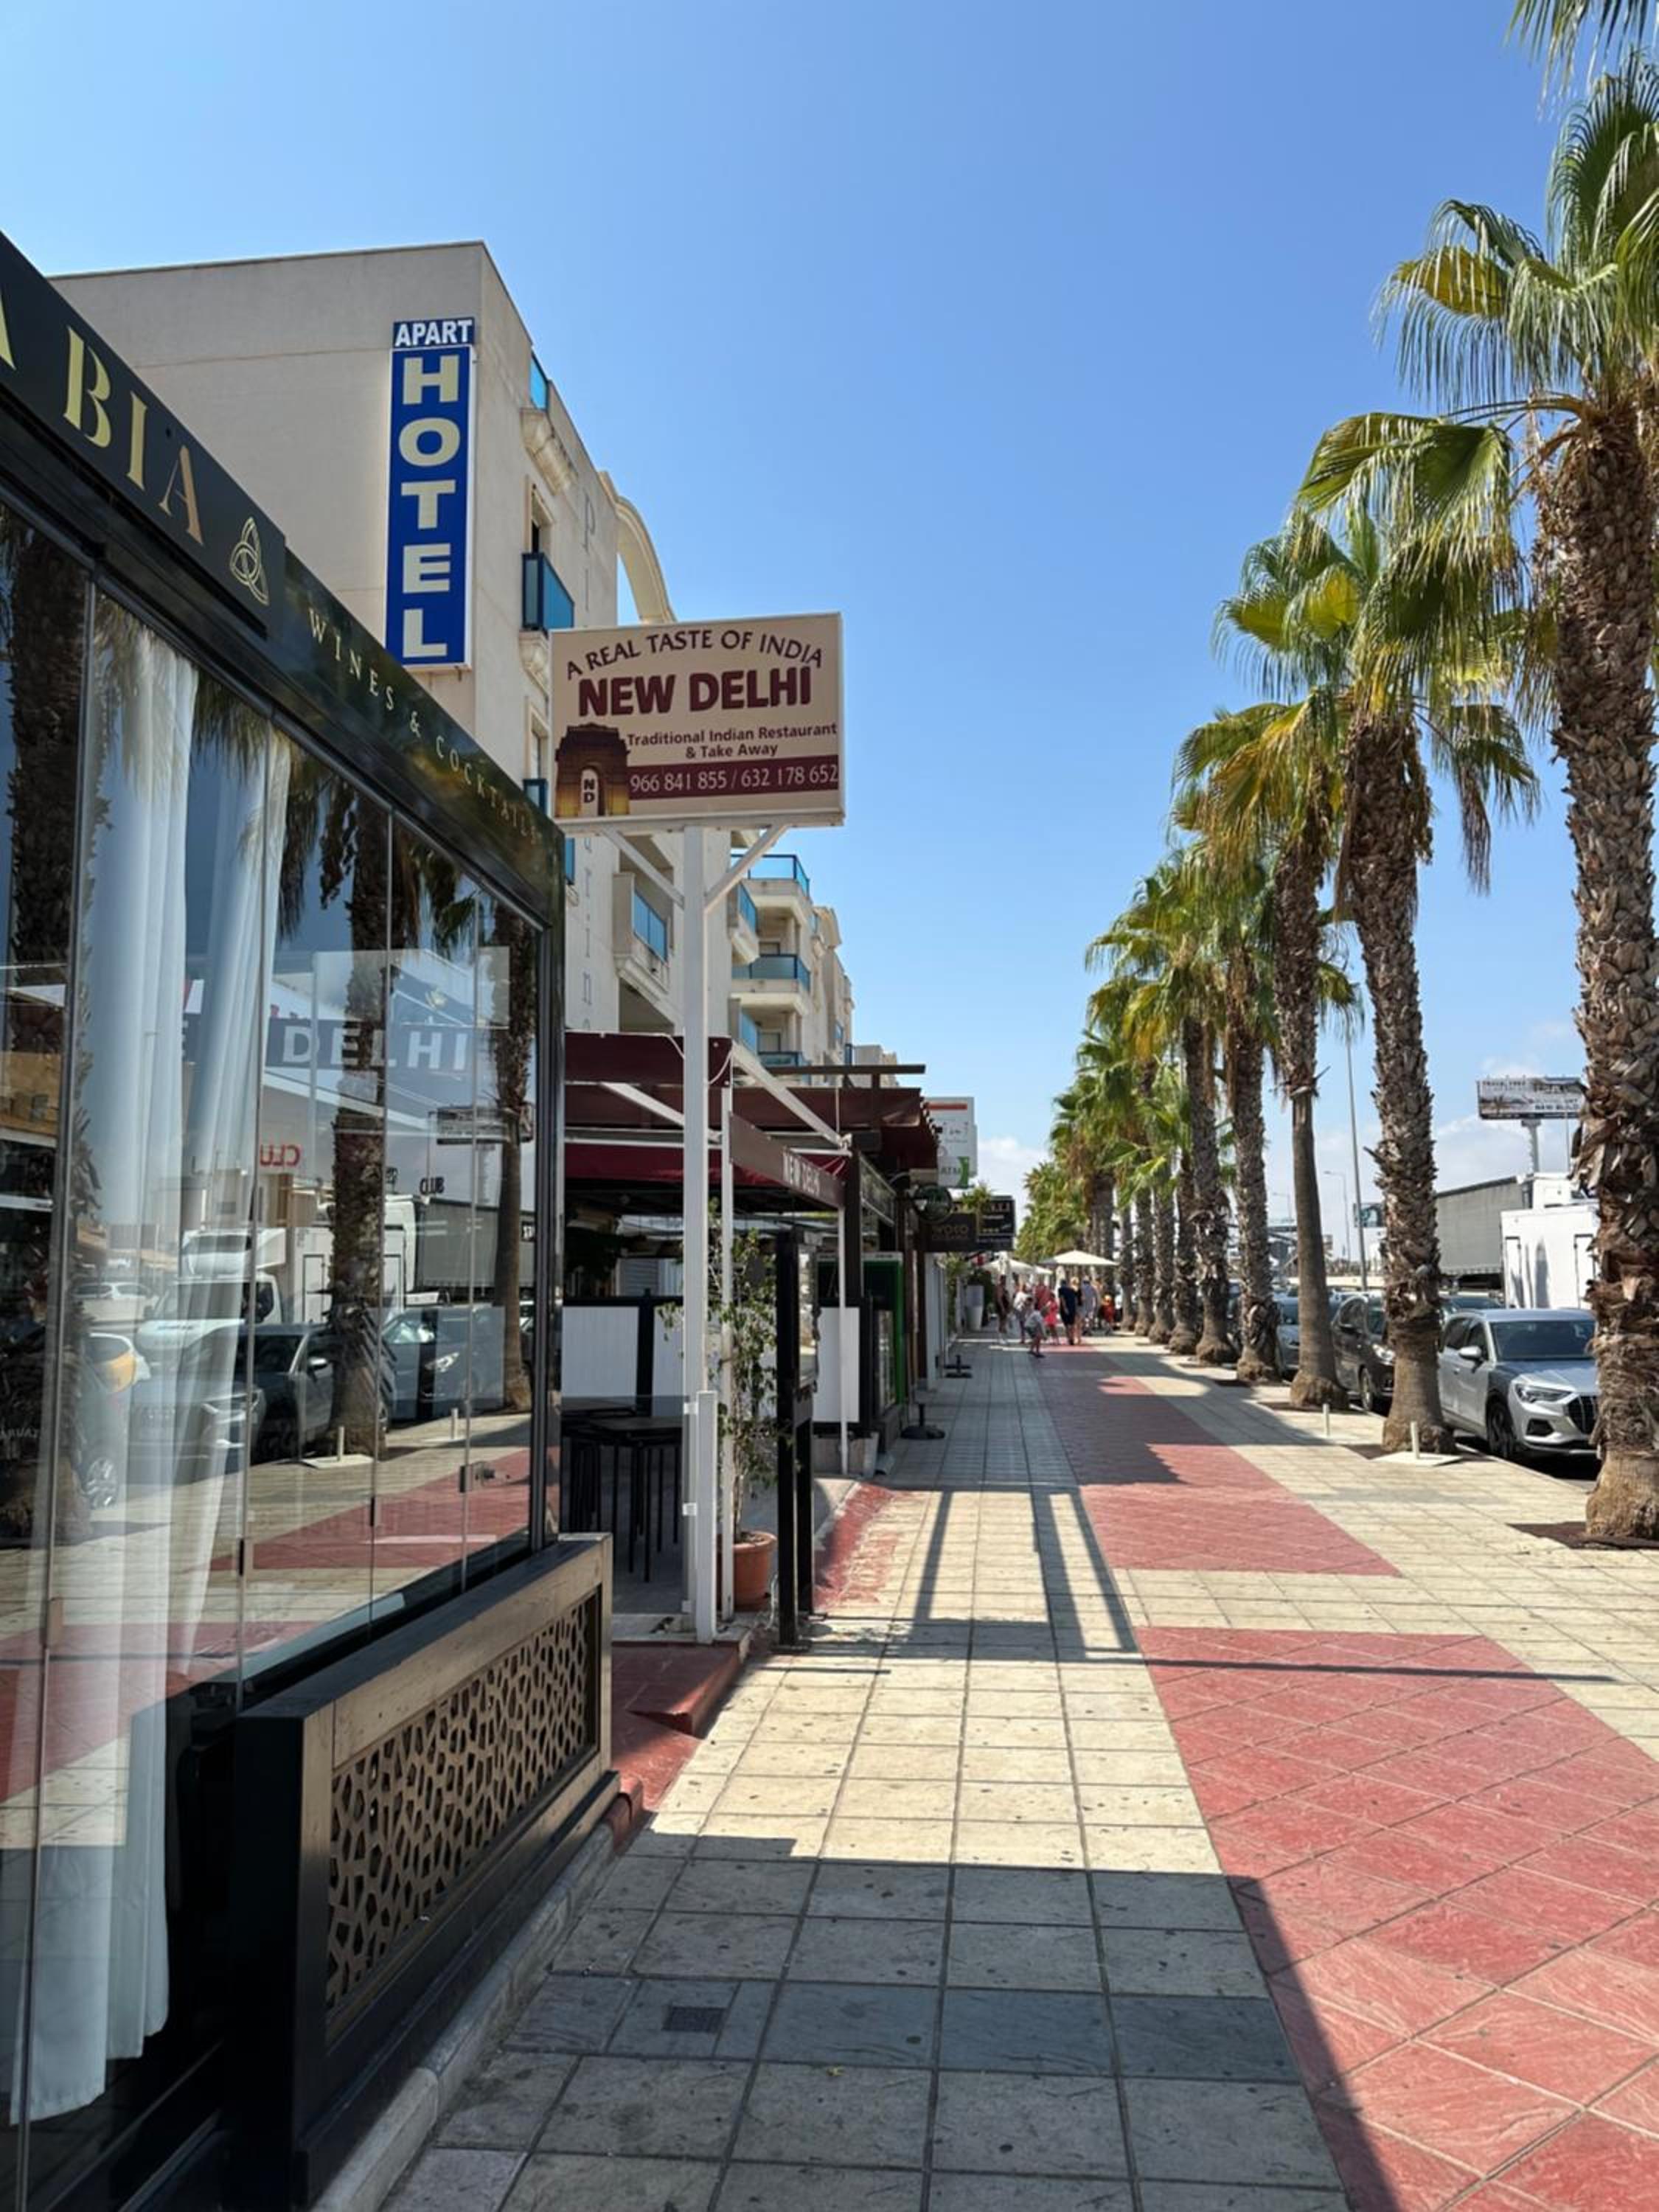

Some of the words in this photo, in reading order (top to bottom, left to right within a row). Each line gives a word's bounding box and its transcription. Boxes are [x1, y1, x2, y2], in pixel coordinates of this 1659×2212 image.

[394, 319, 473, 347] APART
[398, 354, 461, 658] HOTEL
[308, 608, 395, 712] WINES
[409, 710, 422, 738] &
[567, 660, 583, 681] A
[585, 639, 641, 671] REAL
[646, 630, 713, 654] TASTE
[720, 630, 754, 650] OF
[759, 633, 823, 669] INDIA
[579, 674, 676, 717] NEW
[689, 665, 811, 712] DELHI
[627, 730, 705, 746] Traditional
[709, 727, 754, 742] Indian
[758, 722, 838, 740] Restaurant
[685, 747, 696, 759] &
[699, 745, 734, 759] Take
[737, 743, 779, 758] Away
[630, 774, 660, 793] 966
[664, 773, 691, 791] 841
[698, 771, 728, 790] 855
[740, 768, 770, 787] 632
[778, 766, 805, 786] 178
[808, 764, 839, 783] 652
[282, 1025, 468, 1070] DELHI
